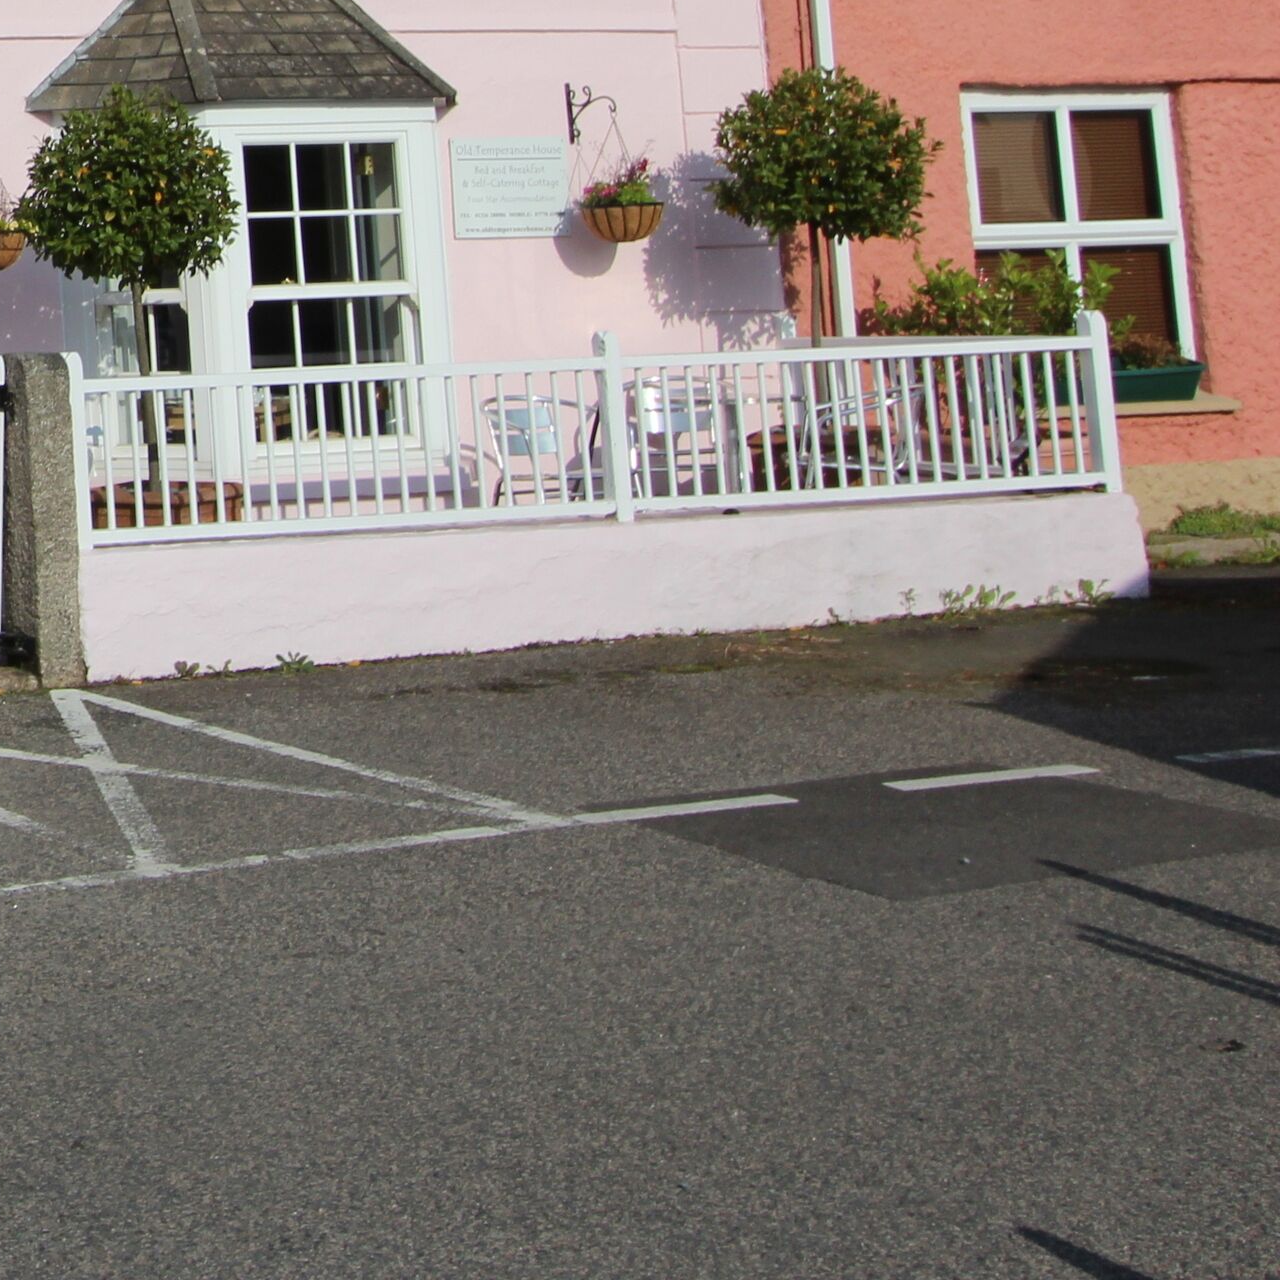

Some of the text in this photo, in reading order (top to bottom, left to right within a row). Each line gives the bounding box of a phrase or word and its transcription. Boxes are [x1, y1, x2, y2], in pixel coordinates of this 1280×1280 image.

[455, 145, 562, 157] Old Temperance House
[474, 164, 545, 175] Bed and Breakfast
[471, 178, 526, 190] Self-Catering
[527, 178, 560, 189] Cottage
